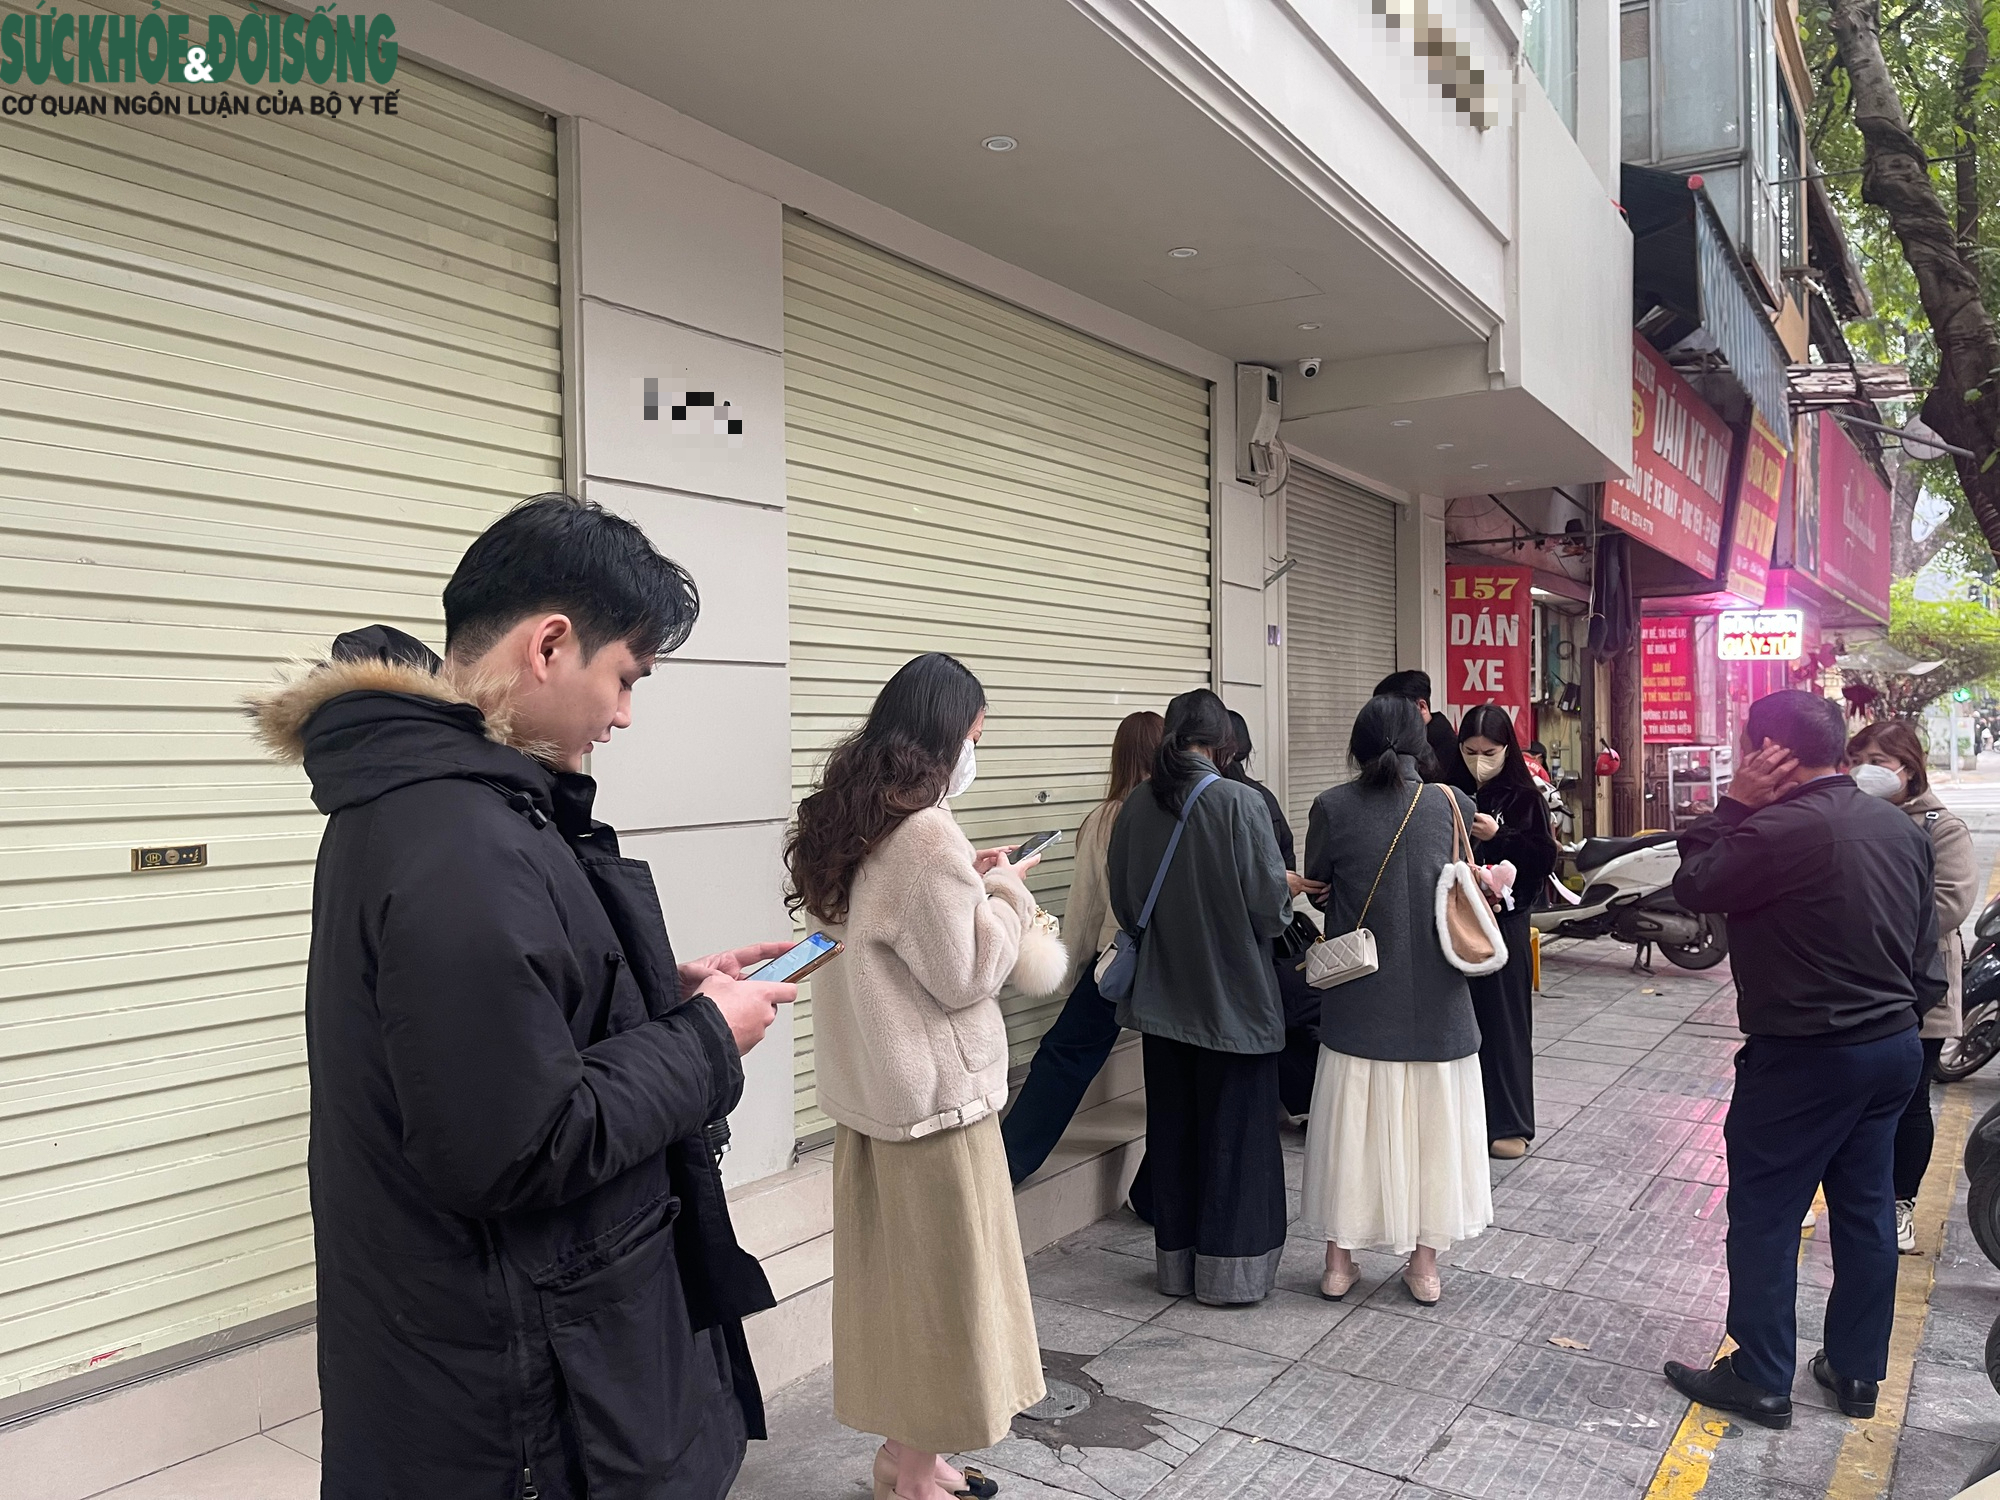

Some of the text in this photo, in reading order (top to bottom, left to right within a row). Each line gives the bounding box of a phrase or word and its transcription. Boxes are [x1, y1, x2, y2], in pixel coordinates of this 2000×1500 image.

[1653, 383, 1687, 471] DÁN
[1686, 416, 1706, 487] XE
[1450, 576, 1520, 600] 157
[1450, 606, 1520, 647] DÁN
[1462, 658, 1504, 692] XE
